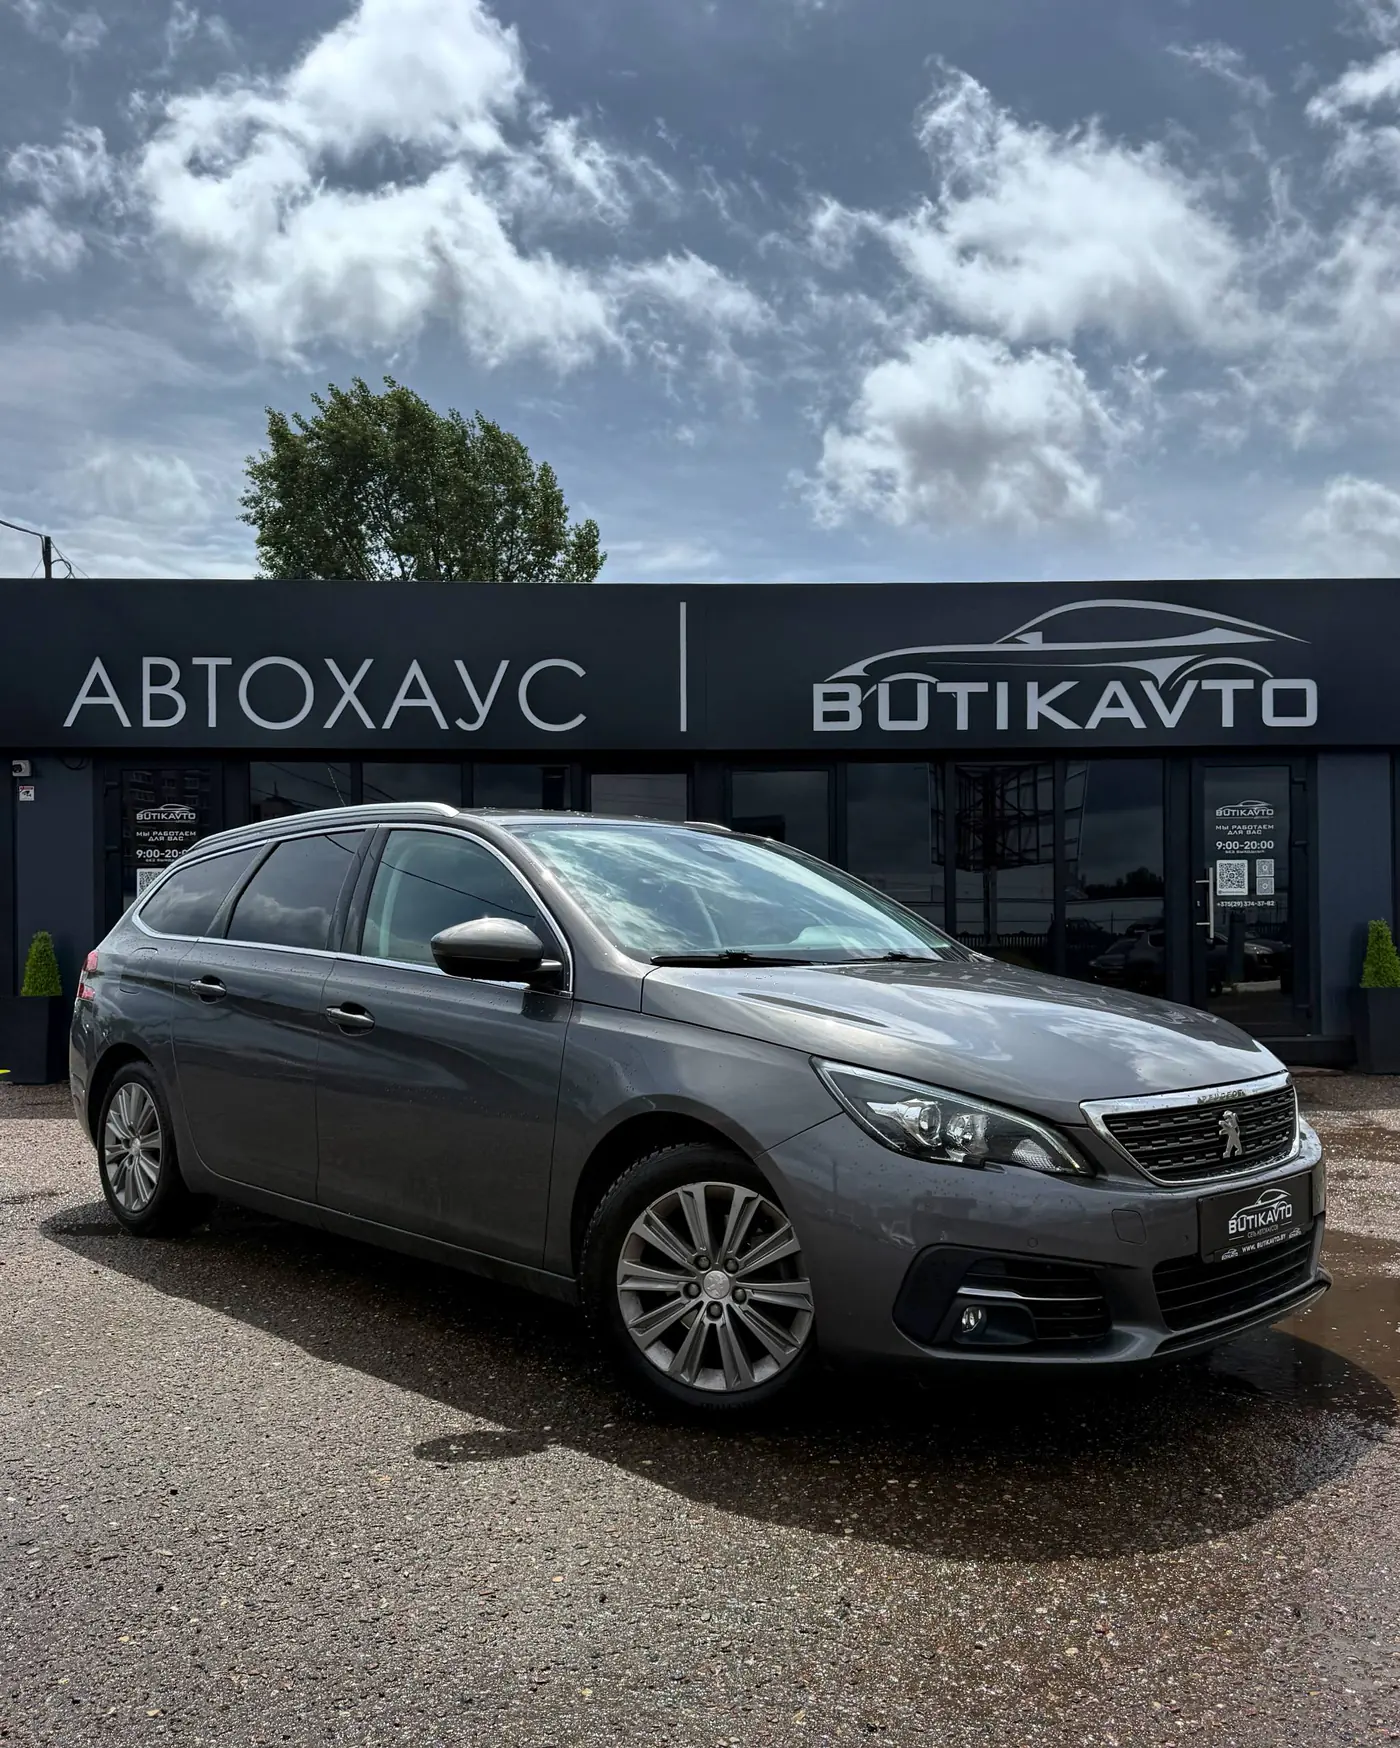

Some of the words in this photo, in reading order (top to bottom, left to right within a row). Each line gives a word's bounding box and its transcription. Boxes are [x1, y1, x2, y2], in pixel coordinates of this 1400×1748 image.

[63, 656, 588, 732] АВТОХАУС
[813, 678, 1318, 732] BUTIKAVTO
[136, 812, 196, 821] BUTIKAVTO
[1216, 808, 1274, 817] BUTIKAVTO
[1216, 840, 1275, 850] 9:00-20:00
[136, 849, 189, 859] 9:00-20:0
[1228, 1203, 1293, 1235] BUTIKAVTO
